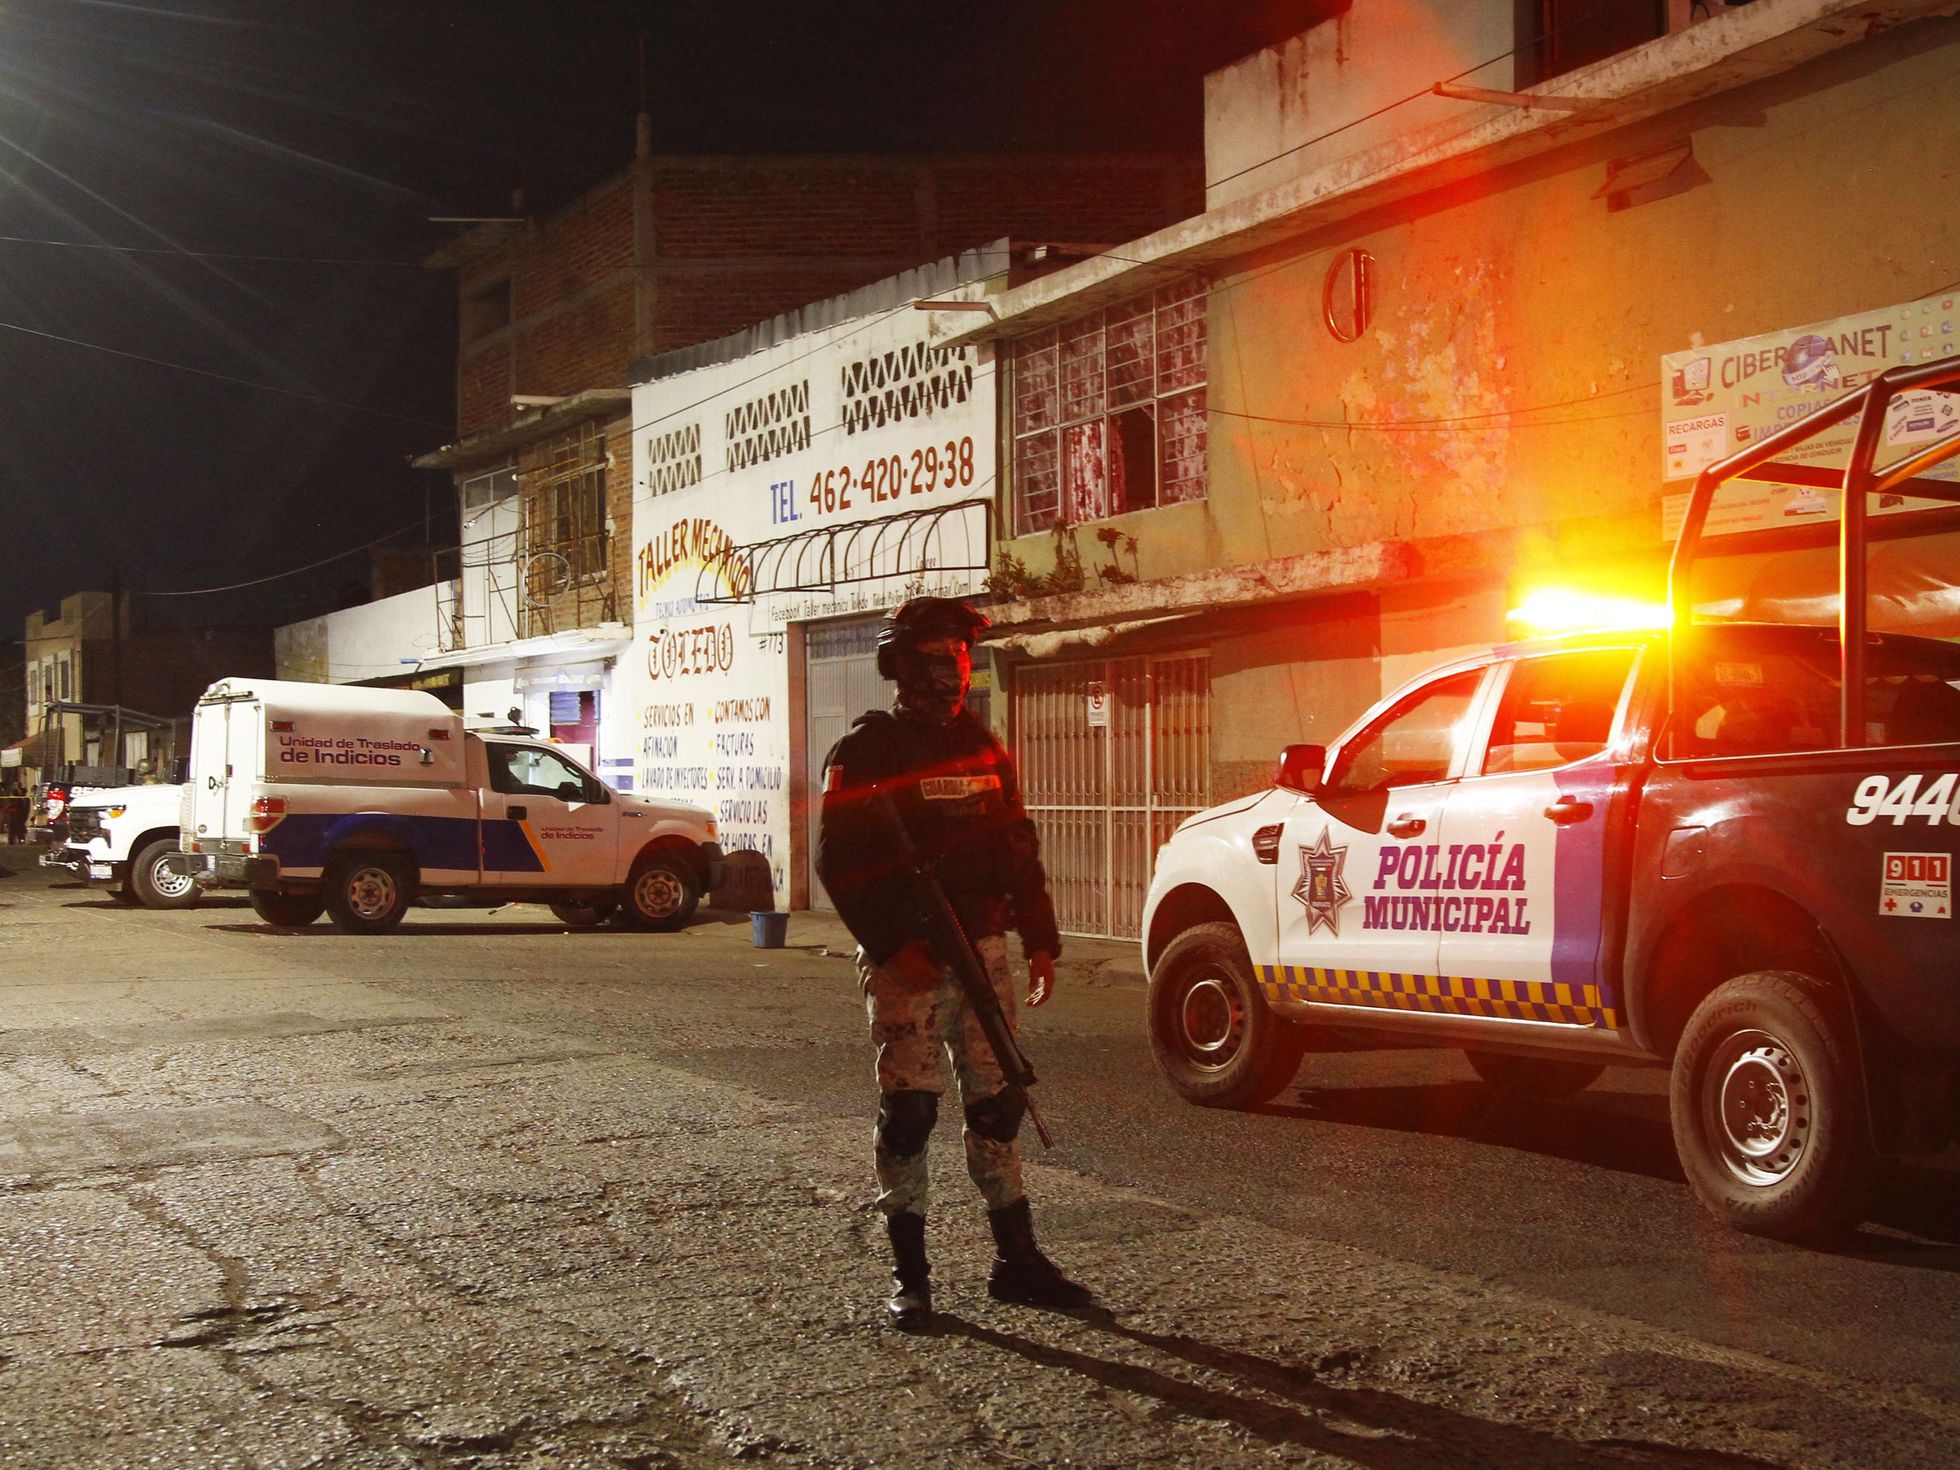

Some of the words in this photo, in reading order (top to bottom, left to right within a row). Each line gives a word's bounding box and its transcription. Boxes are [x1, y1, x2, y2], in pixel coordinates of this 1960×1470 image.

[1721, 346, 1788, 388] CIBER
[1668, 417, 1725, 434] RECARGAS
[770, 480, 802, 524] TEL.
[638, 518, 688, 598] TALLER
[648, 622, 734, 684] TOLEDO
[759, 632, 784, 654] #773
[643, 704, 681, 728] SERVICIOS
[685, 702, 694, 726] EN
[715, 699, 753, 724] CONTAMOS
[755, 697, 770, 722] CON
[280, 736, 333, 748] Unidad
[336, 738, 354, 749] de
[357, 738, 421, 752] Traslado
[280, 748, 309, 763] de
[315, 749, 401, 765] Indicios
[717, 732, 754, 757] FACTURAS
[675, 766, 707, 790] INYECTORES
[717, 766, 736, 790] SERV.
[739, 767, 744, 790] A
[746, 766, 782, 790] DOMICILIO
[720, 799, 751, 823] SERVICIO
[754, 800, 768, 825] LAS
[541, 832, 554, 840] de
[556, 832, 594, 840] Indicios
[762, 834, 773, 858] EN
[1373, 830, 1526, 890] POLICÍA
[1884, 888, 1948, 898] EMERGENCIAS
[1363, 896, 1531, 935] MUNICIPAL
